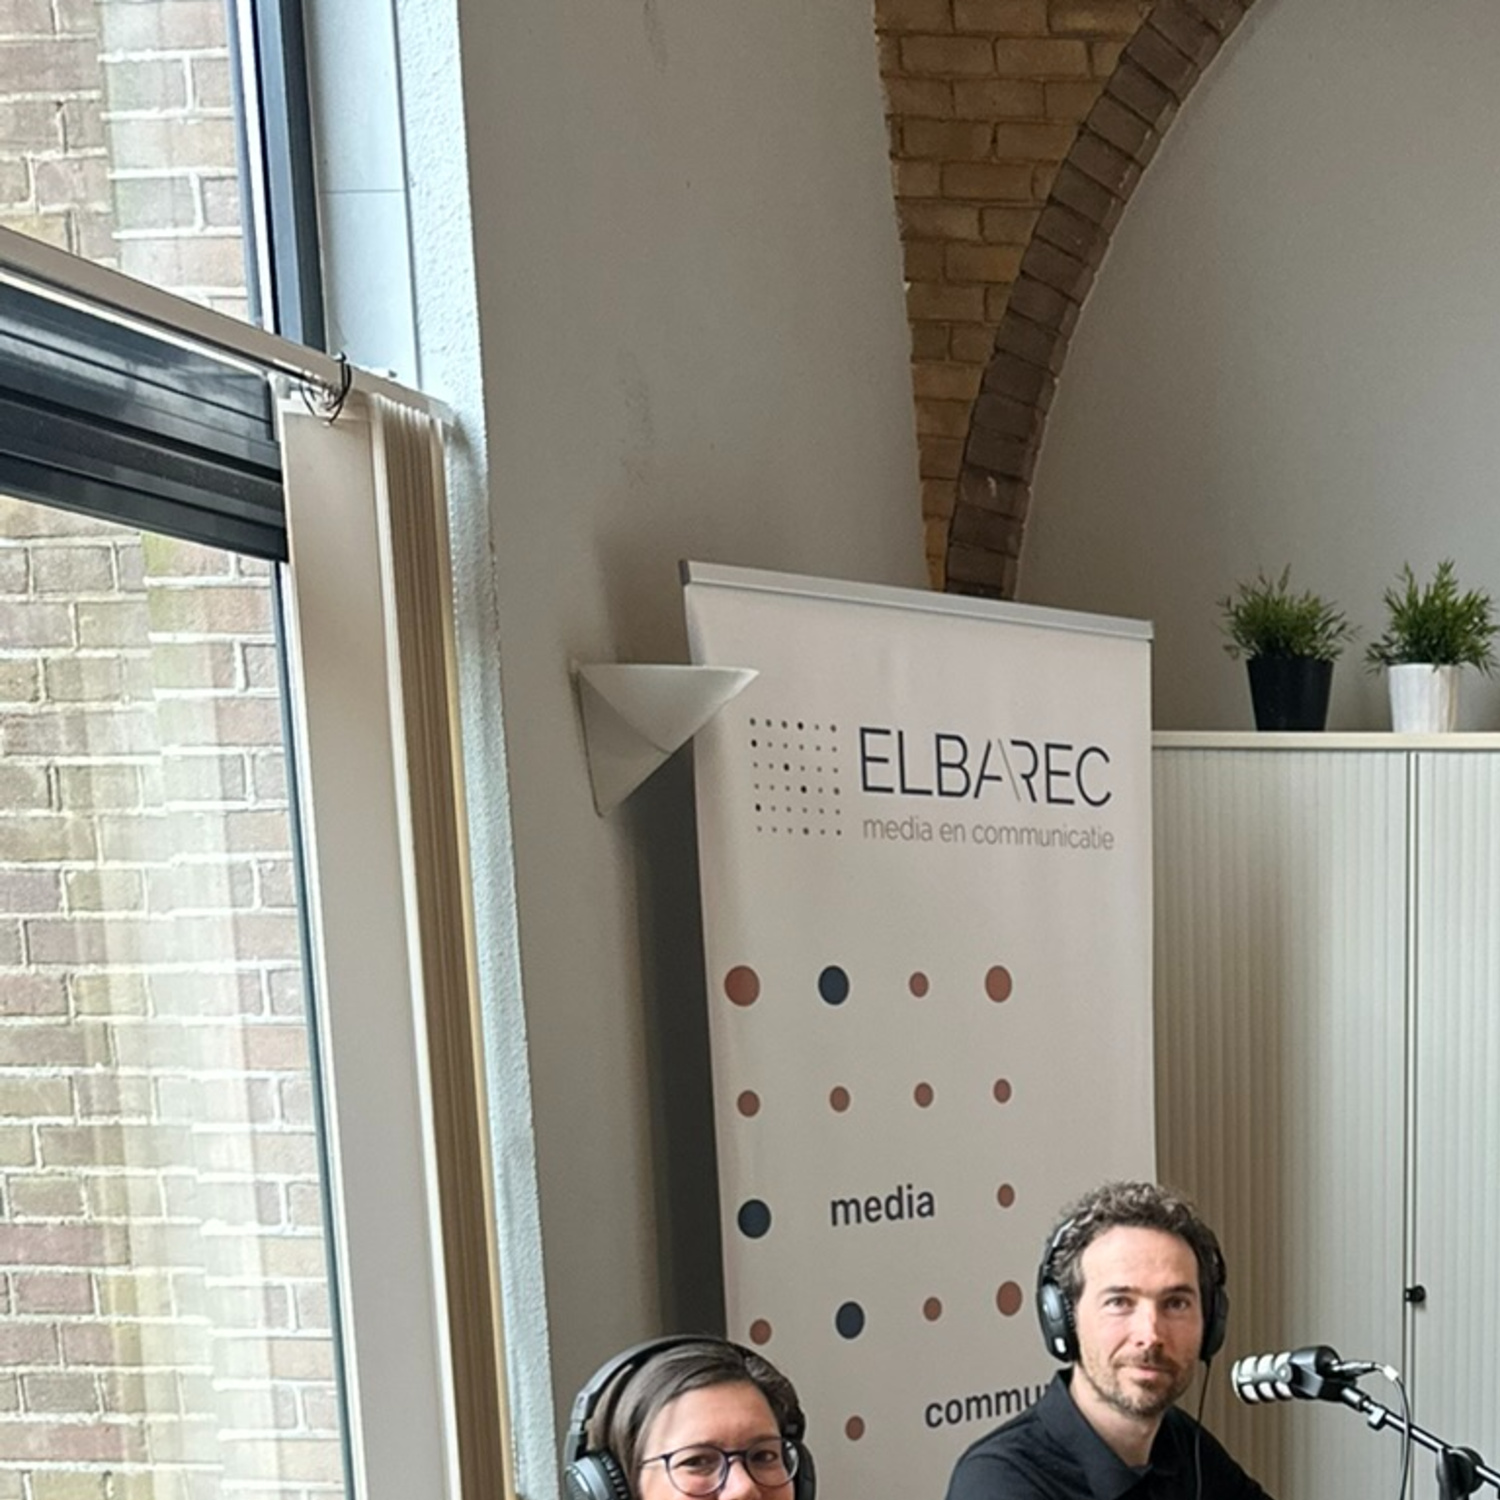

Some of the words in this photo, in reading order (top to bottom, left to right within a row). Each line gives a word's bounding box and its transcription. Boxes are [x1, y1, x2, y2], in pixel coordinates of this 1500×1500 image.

[860, 727, 1112, 807] ELBAREC
[863, 814, 933, 842] media
[940, 820, 966, 843] en
[972, 822, 1115, 850] communicatie
[830, 1183, 936, 1226] media
[925, 1383, 1051, 1429] commu
